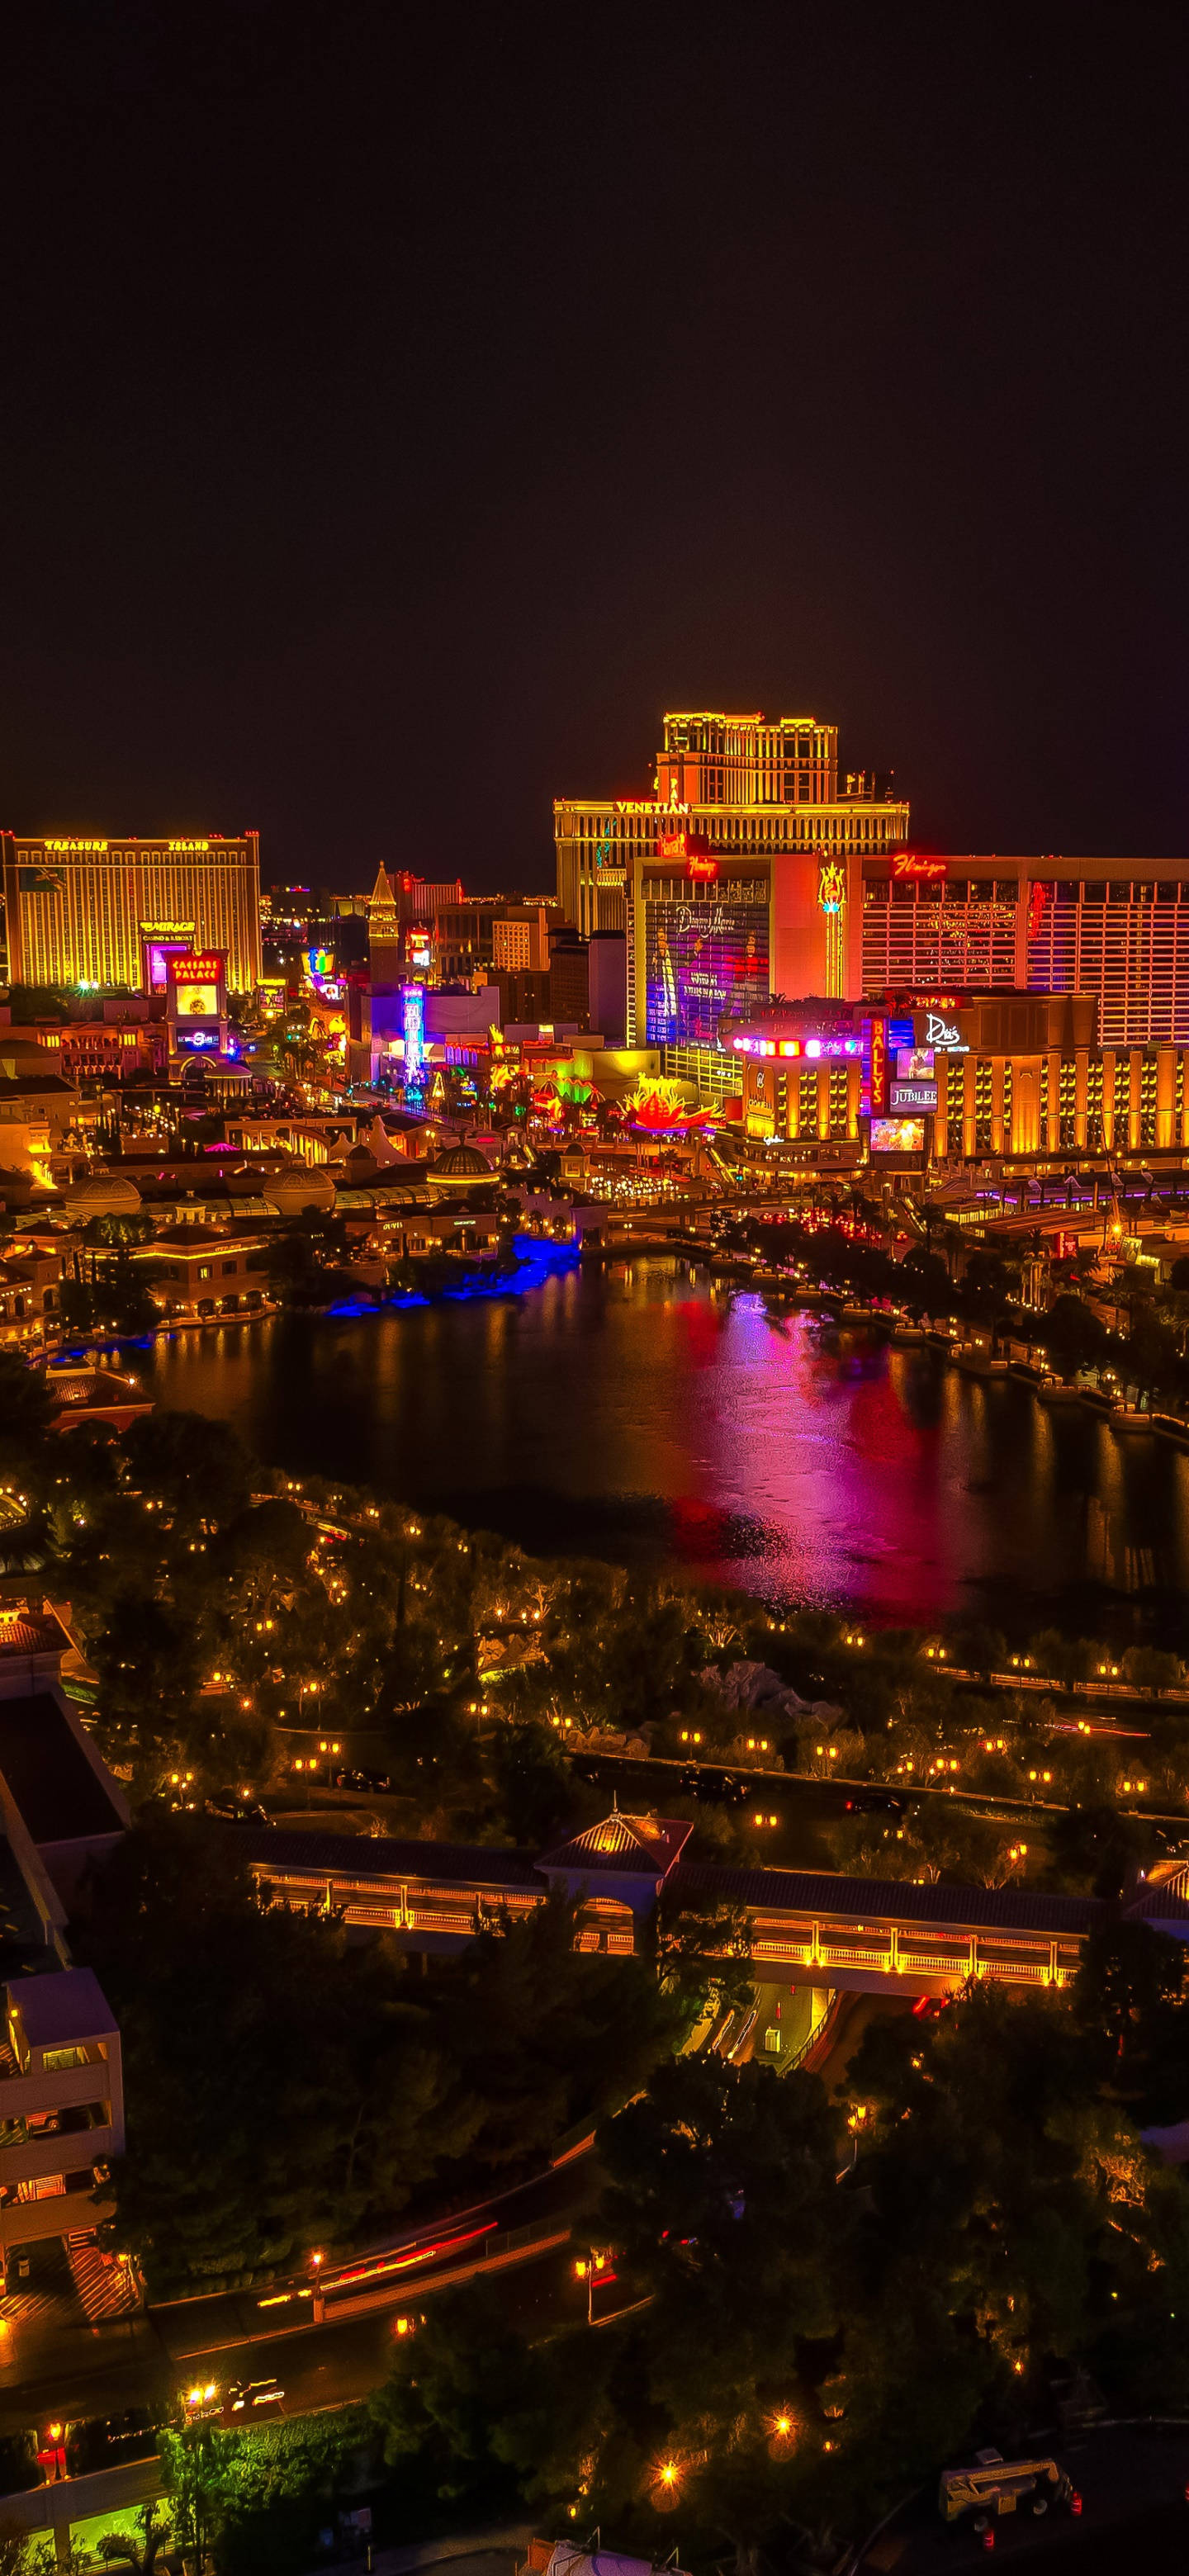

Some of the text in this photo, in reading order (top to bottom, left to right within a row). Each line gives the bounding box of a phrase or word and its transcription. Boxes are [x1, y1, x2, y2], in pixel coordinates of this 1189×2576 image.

[616, 801, 689, 814] VENETIAN
[45, 841, 210, 851] TREASURE ISLAND
[154, 921, 196, 933] MIRAGE
[172, 960, 218, 969] CAESARS
[175, 970, 216, 979] PALACE
[891, 1088, 937, 1105] JUBILEE
